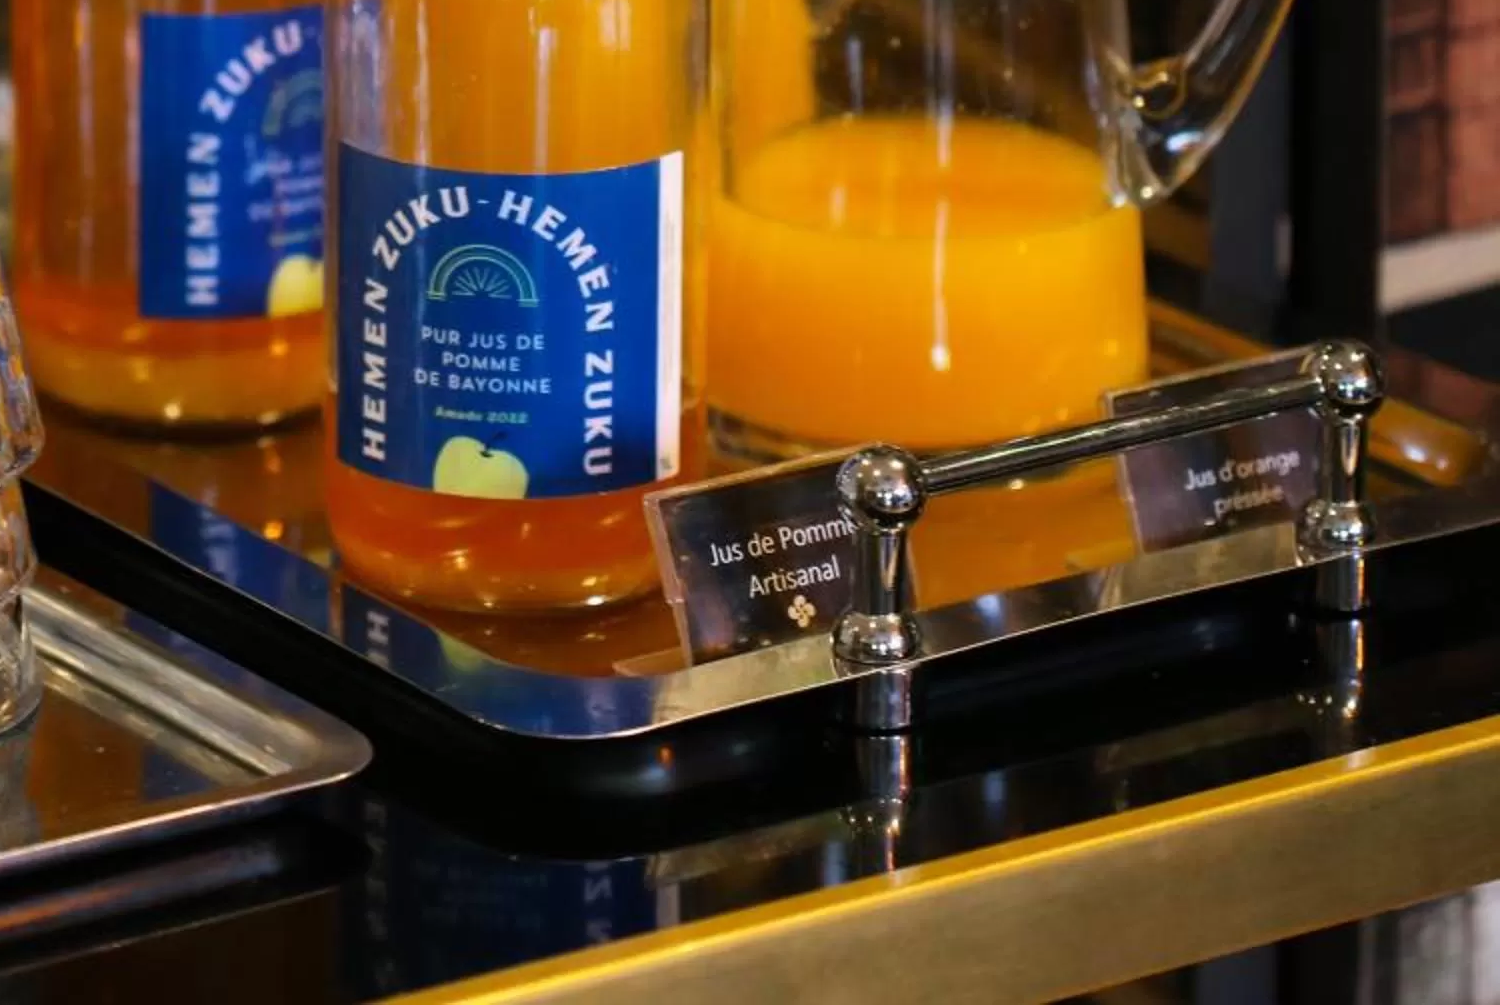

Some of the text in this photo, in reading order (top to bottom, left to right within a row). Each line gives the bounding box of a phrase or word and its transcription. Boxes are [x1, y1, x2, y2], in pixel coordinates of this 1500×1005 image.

[200, 20, 303, 121] ZUKU
[185, 132, 222, 305] HEMEN
[421, 326, 545, 351] PUR JUS DE
[362, 279, 389, 461] HEMEN
[583, 350, 613, 476] ZUKU
[442, 352, 521, 372] POMME
[414, 368, 551, 395] DE BAYONNE
[1184, 467, 1217, 491] Jus
[710, 542, 744, 566] Jus
[747, 532, 777, 557] de
[748, 554, 841, 600] Artisanal
